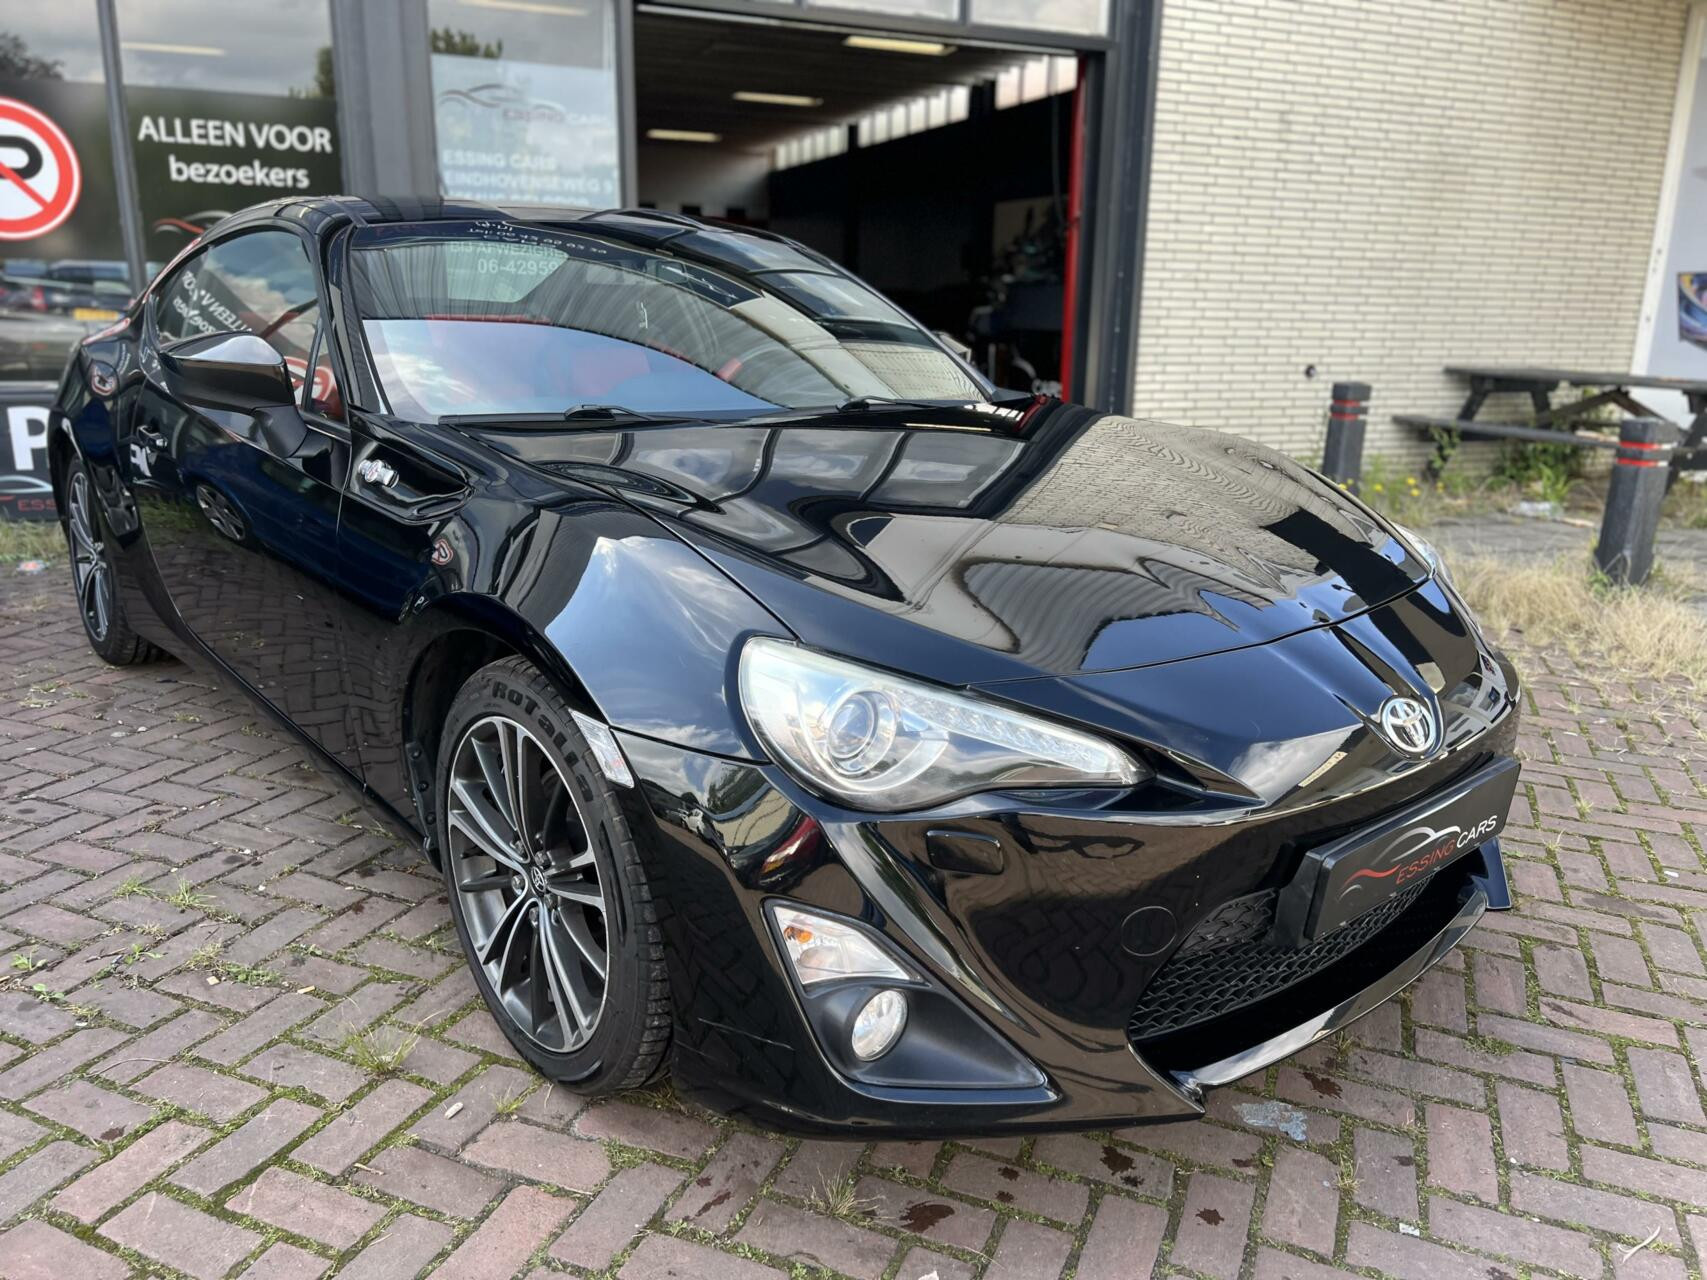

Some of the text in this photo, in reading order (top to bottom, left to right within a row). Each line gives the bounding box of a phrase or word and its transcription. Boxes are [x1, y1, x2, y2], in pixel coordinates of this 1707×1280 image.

[138, 116, 333, 153] ALLEEN VOOR
[168, 154, 310, 188] bezoekers
[1395, 814, 1498, 886] ESSING CARS
